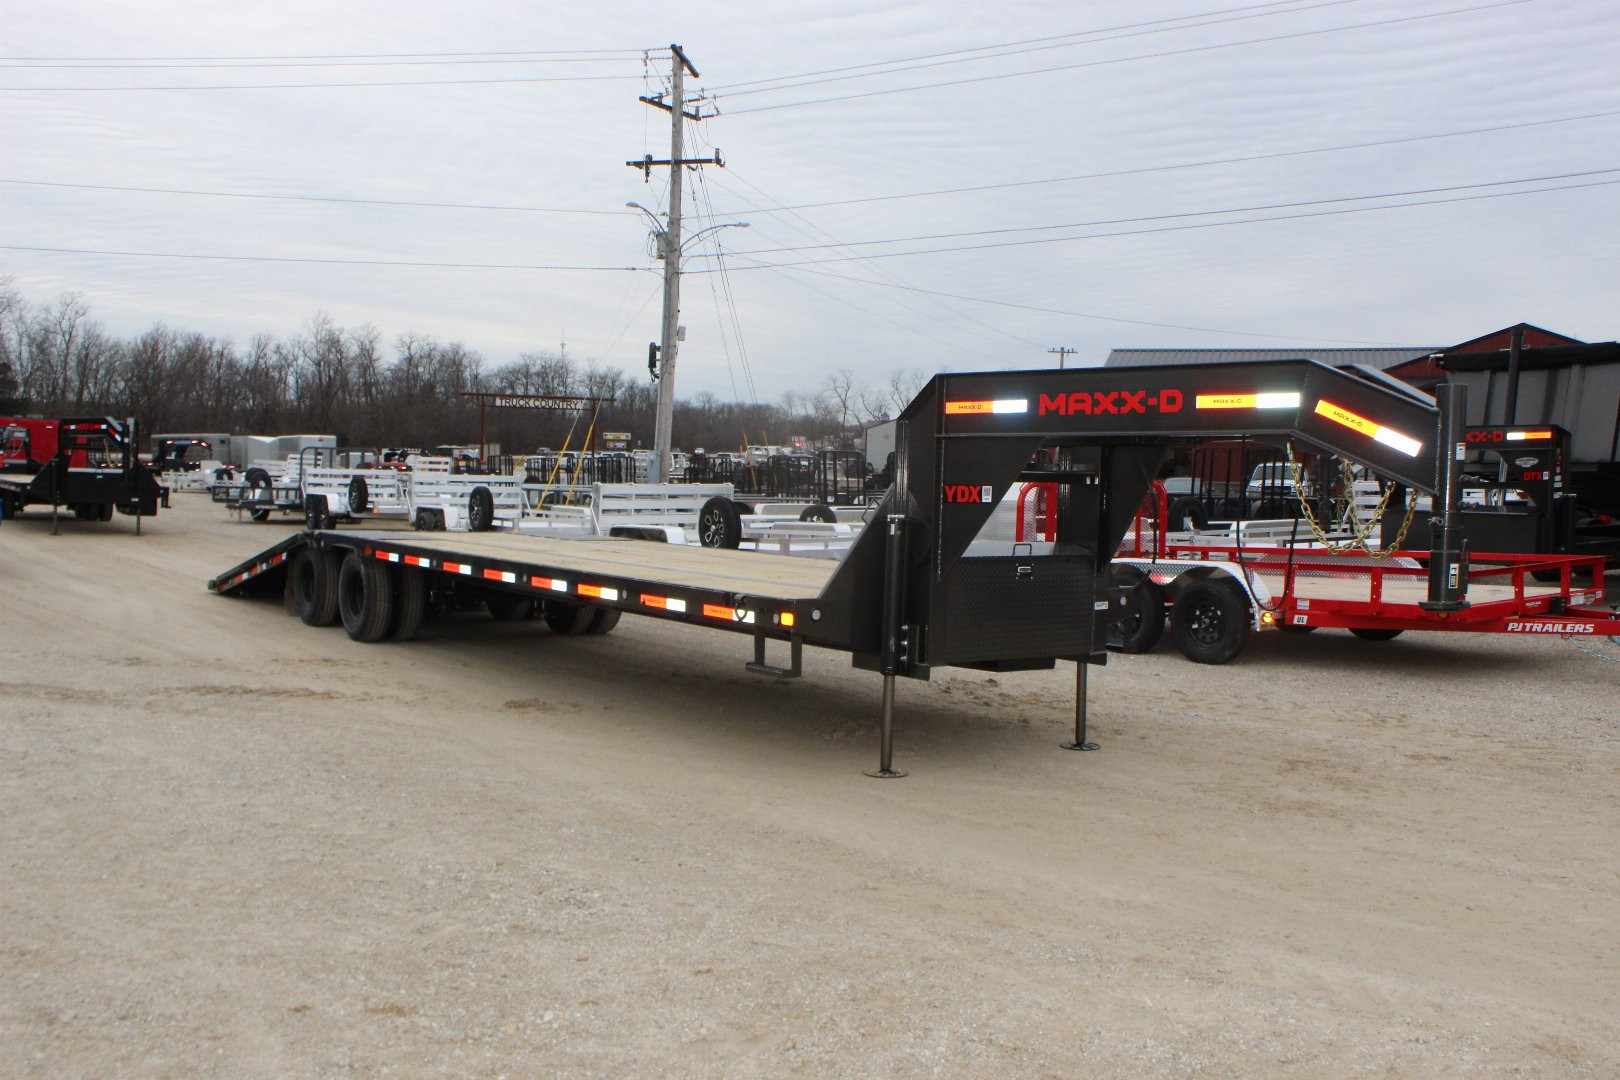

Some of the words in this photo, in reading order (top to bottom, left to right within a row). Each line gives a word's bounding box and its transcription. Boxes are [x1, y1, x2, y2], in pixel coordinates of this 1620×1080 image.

[501, 398, 532, 407] TRUCK
[534, 399, 579, 409] COUNTRY
[1039, 389, 1183, 416] MAXX-D
[1524, 472, 1542, 480] DTX
[944, 485, 982, 503] YDX
[1508, 623, 1522, 631] PJ
[1524, 622, 1595, 633] TRAILERS
